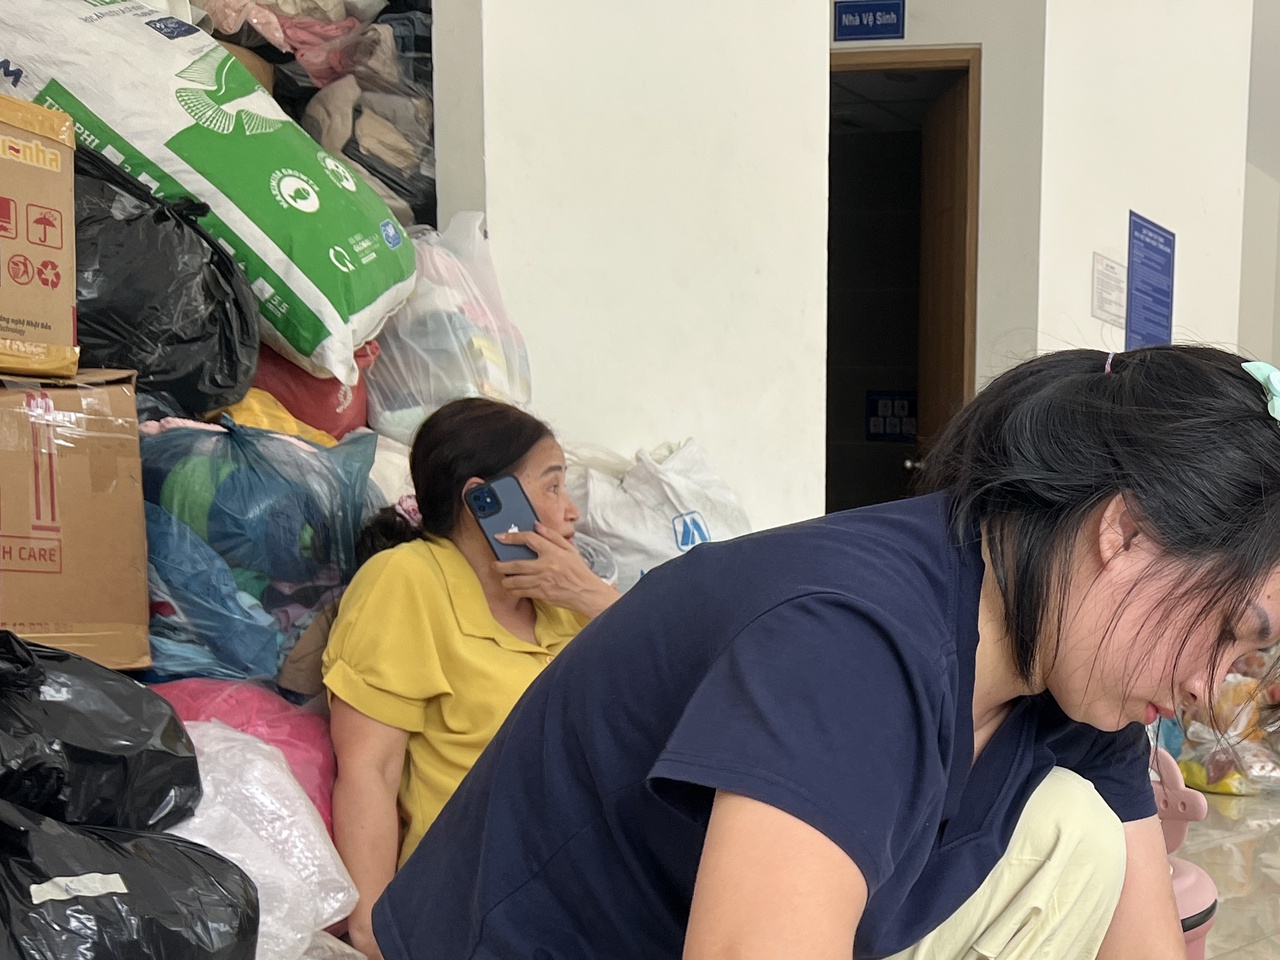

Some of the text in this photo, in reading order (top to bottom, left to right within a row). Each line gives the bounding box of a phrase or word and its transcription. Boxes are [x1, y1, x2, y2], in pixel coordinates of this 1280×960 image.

[842, 11, 897, 27] Nhà Vệ Sinh
[18, 546, 57, 562] CARE
